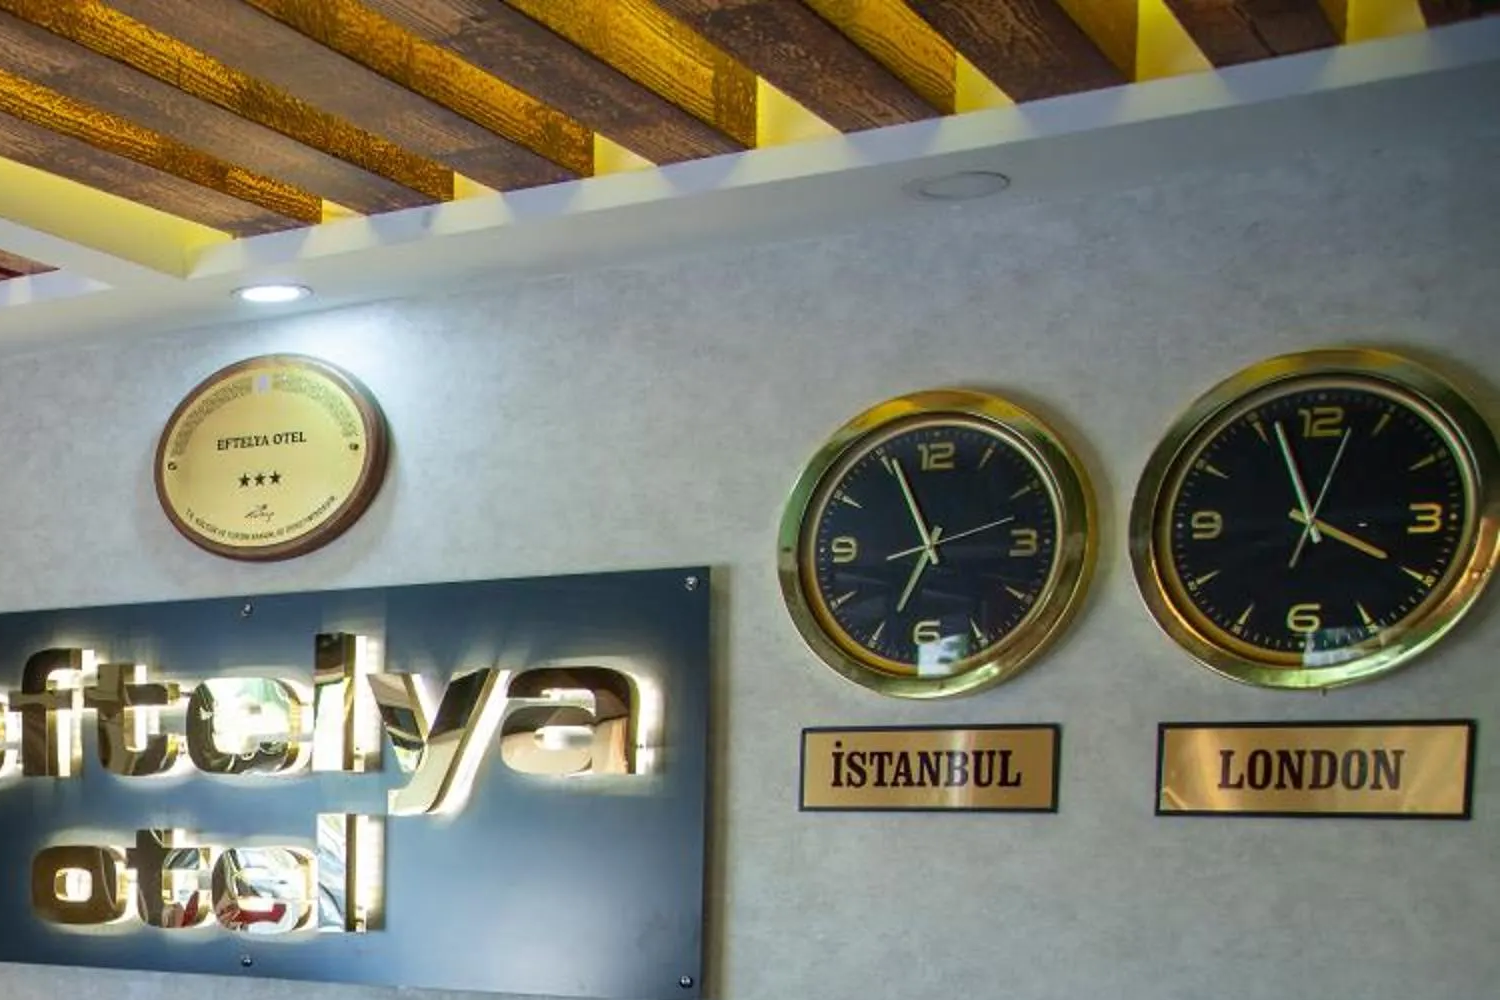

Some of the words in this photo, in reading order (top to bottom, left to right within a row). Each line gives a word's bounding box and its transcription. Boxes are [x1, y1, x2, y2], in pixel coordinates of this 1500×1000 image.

[1297, 406, 1346, 438] 12
[217, 435, 269, 451] EFTELYA
[273, 431, 307, 445] OTEL
[916, 441, 956, 471] 12
[1191, 510, 1223, 541] 9
[1406, 502, 1443, 534] 3
[831, 535, 858, 563] 9
[1008, 527, 1039, 557] 3
[913, 619, 941, 645] 6
[1287, 602, 1321, 633] 6
[830, 740, 1023, 789] İSTANBUL
[1217, 748, 1406, 792] LONDON
[31, 812, 382, 934] otel
